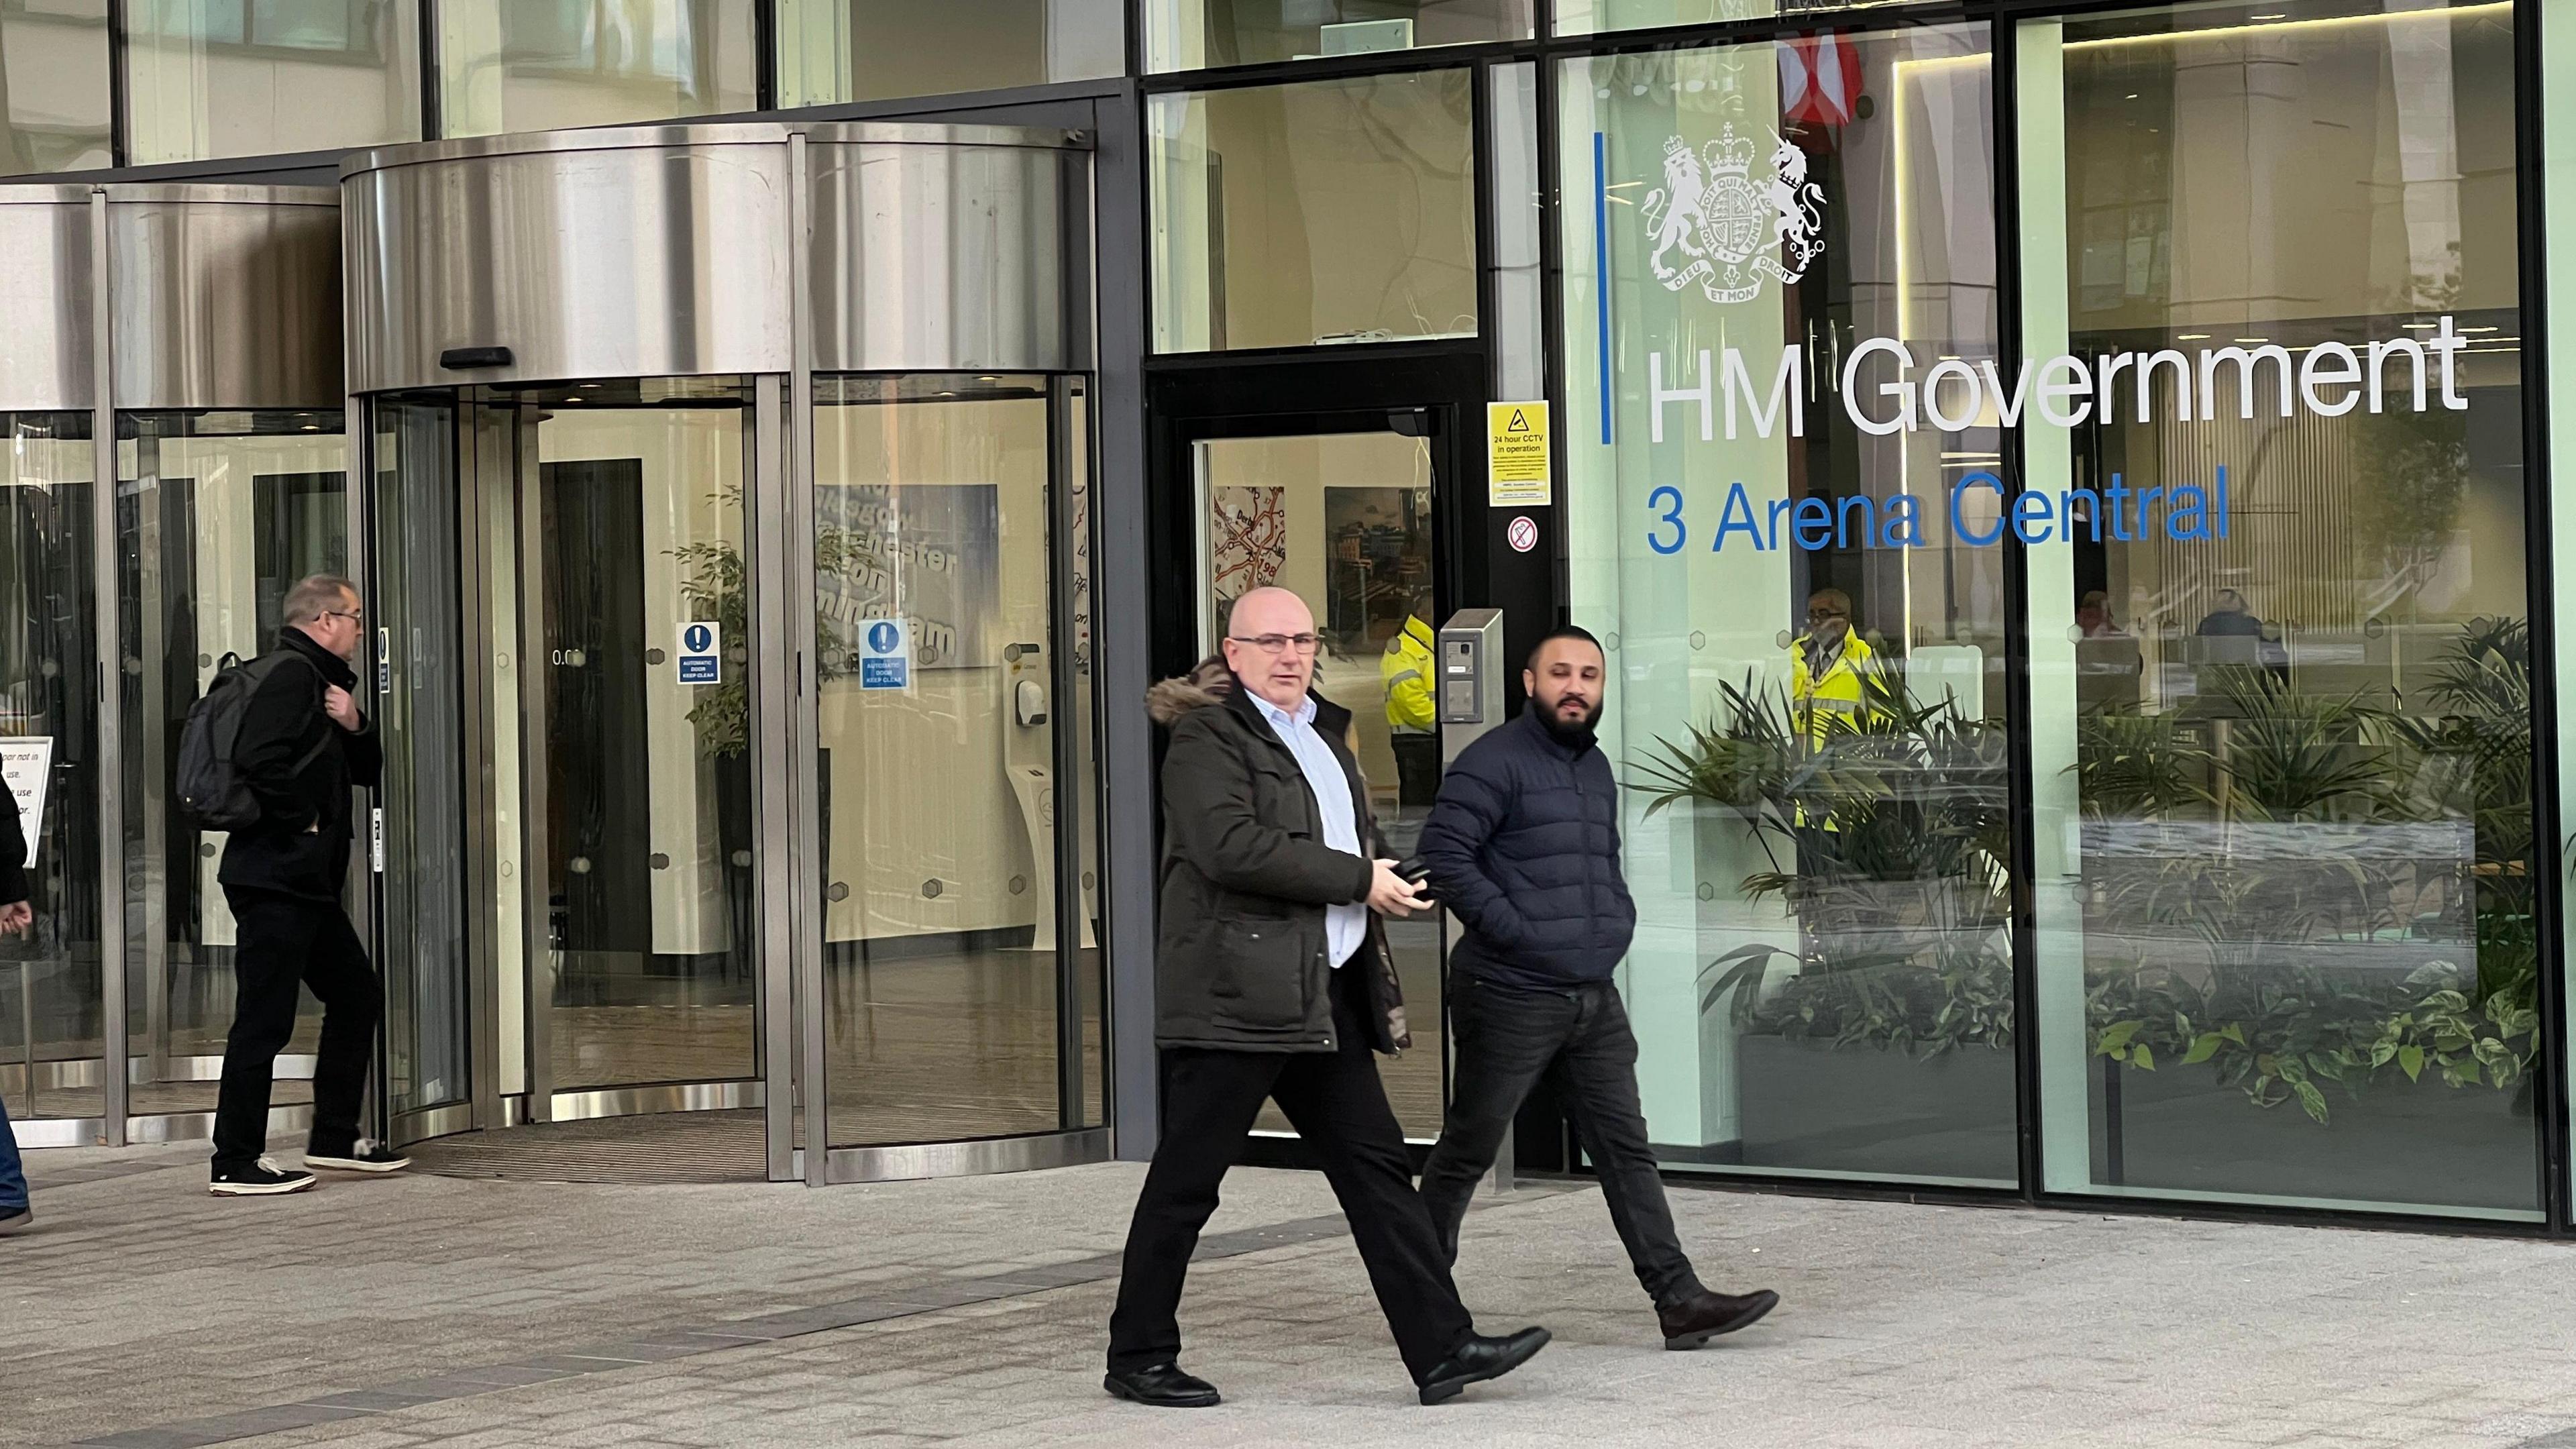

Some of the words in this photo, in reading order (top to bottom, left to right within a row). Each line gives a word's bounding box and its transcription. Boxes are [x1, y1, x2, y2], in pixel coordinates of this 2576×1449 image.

[1717, 177, 1737, 189] QUI
[1743, 215, 1762, 251] PENSE
[1674, 262, 1701, 288] DIEU
[1711, 290, 1725, 301] ET
[1727, 288, 1755, 301] MON
[1760, 258, 1794, 282] DROIT
[1650, 343, 1805, 443] HM
[1842, 315, 2469, 436] Government
[1506, 445, 1540, 453] operation
[1523, 435, 1544, 443] CCTV
[1647, 486, 1686, 555] 3
[1712, 482, 1925, 553] Arena
[1949, 465, 2229, 547] Central
[6, 771, 21, 779] use.
[17, 789, 32, 797] use
